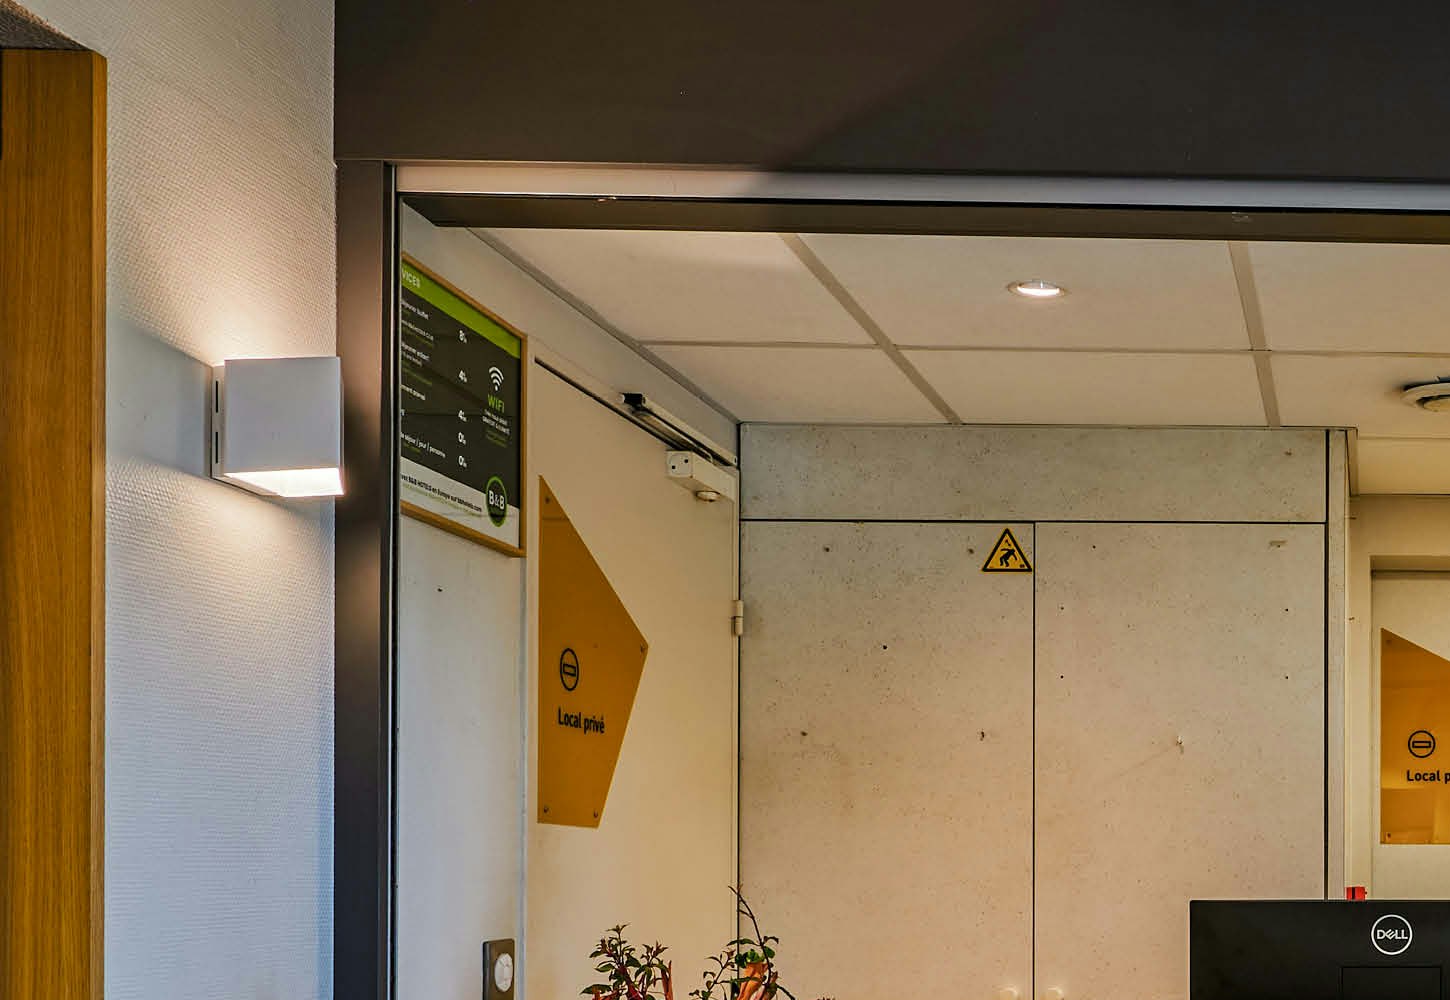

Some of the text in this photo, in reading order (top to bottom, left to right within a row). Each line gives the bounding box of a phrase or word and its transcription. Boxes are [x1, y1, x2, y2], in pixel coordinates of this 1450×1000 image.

[488, 490, 505, 510] B&B
[558, 707, 605, 735] Local privé
[1406, 769, 1440, 782] Local
[1377, 929, 1408, 940] DELL
